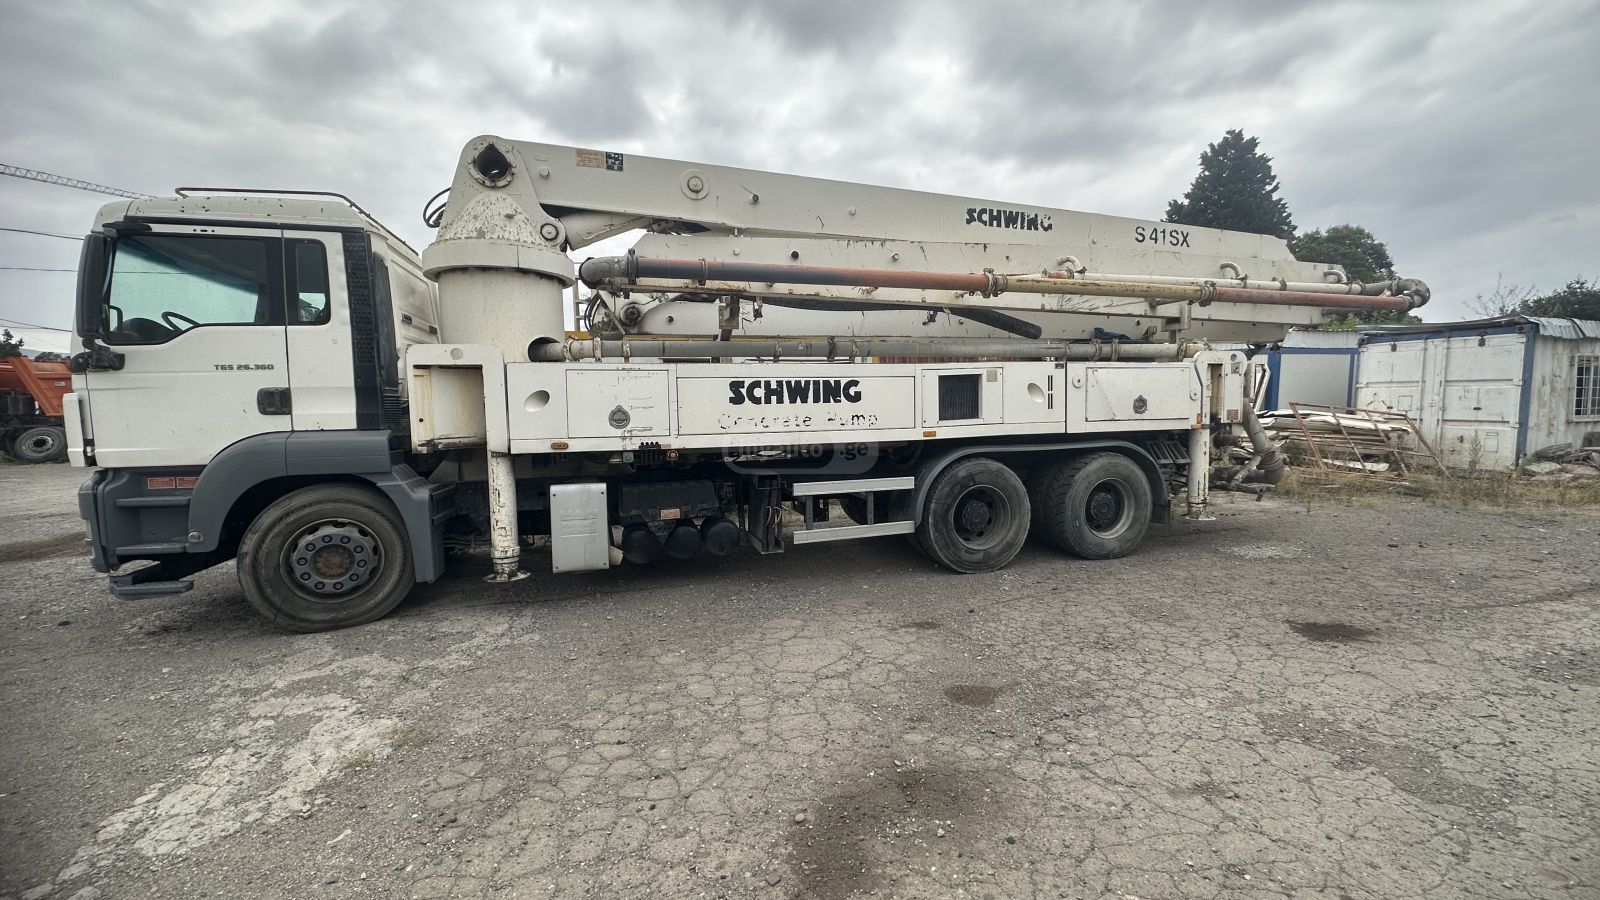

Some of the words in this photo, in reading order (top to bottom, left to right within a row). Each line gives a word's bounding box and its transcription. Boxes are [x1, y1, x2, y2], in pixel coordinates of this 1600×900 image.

[965, 207, 1053, 232] SCHWING
[1134, 226, 1146, 243] S
[1149, 227, 1190, 248] 41SX
[236, 363, 275, 371] 26.360
[728, 379, 862, 405] SCHWING
